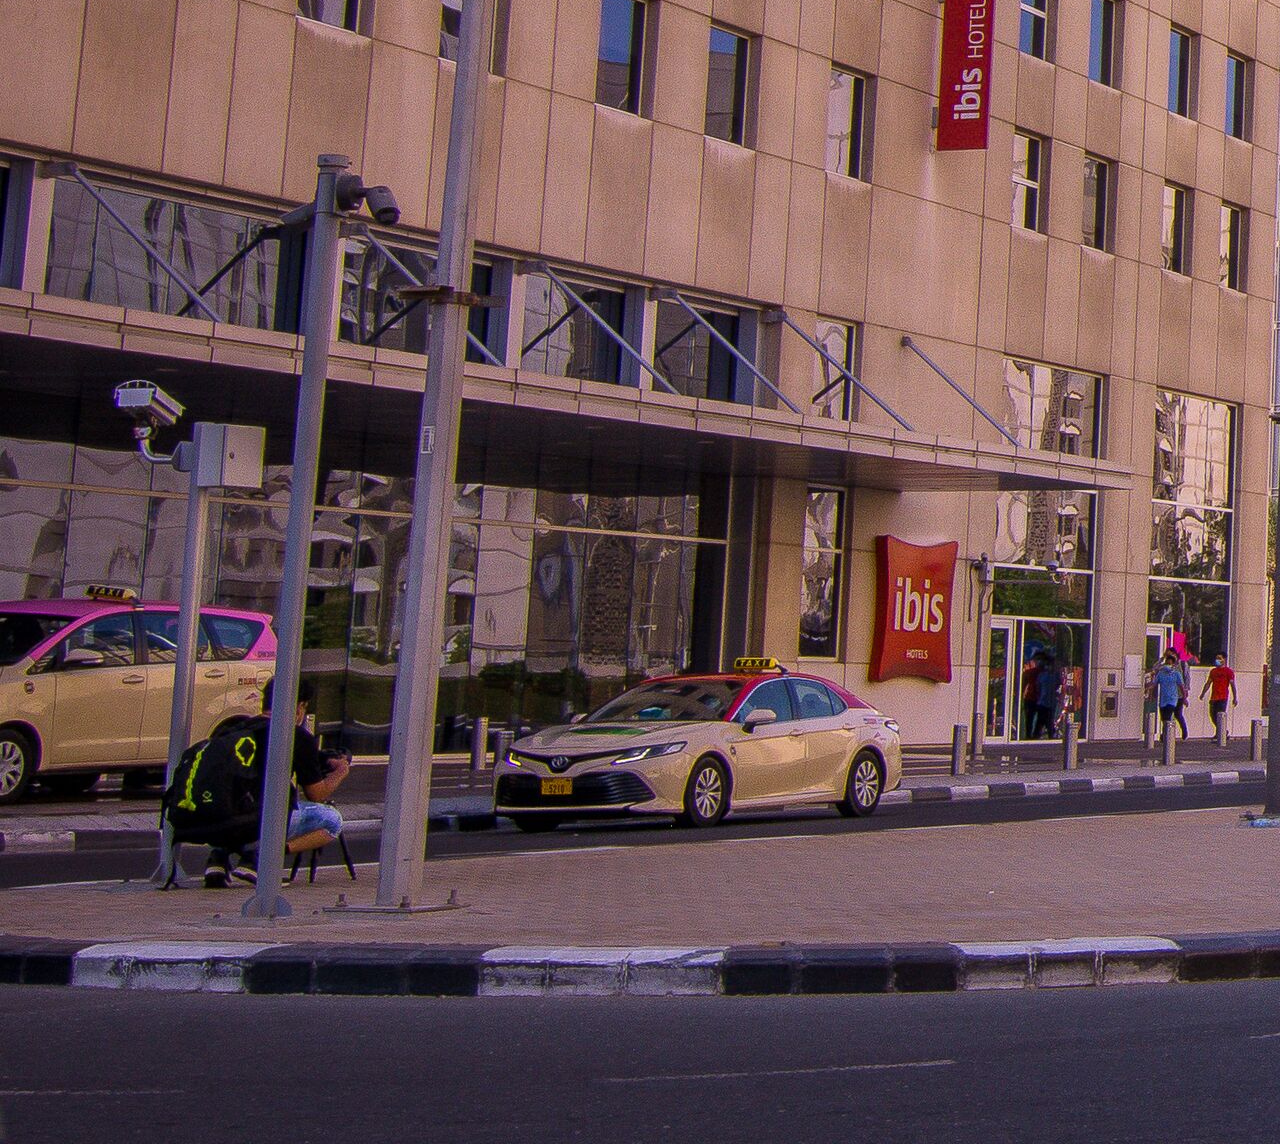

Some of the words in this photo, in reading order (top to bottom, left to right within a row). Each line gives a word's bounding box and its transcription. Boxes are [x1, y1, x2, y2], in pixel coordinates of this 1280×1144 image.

[953, 67, 983, 120] ibis
[93, 586, 121, 597] TAXI
[894, 576, 944, 633] ibis
[906, 649, 929, 660] HOTELS
